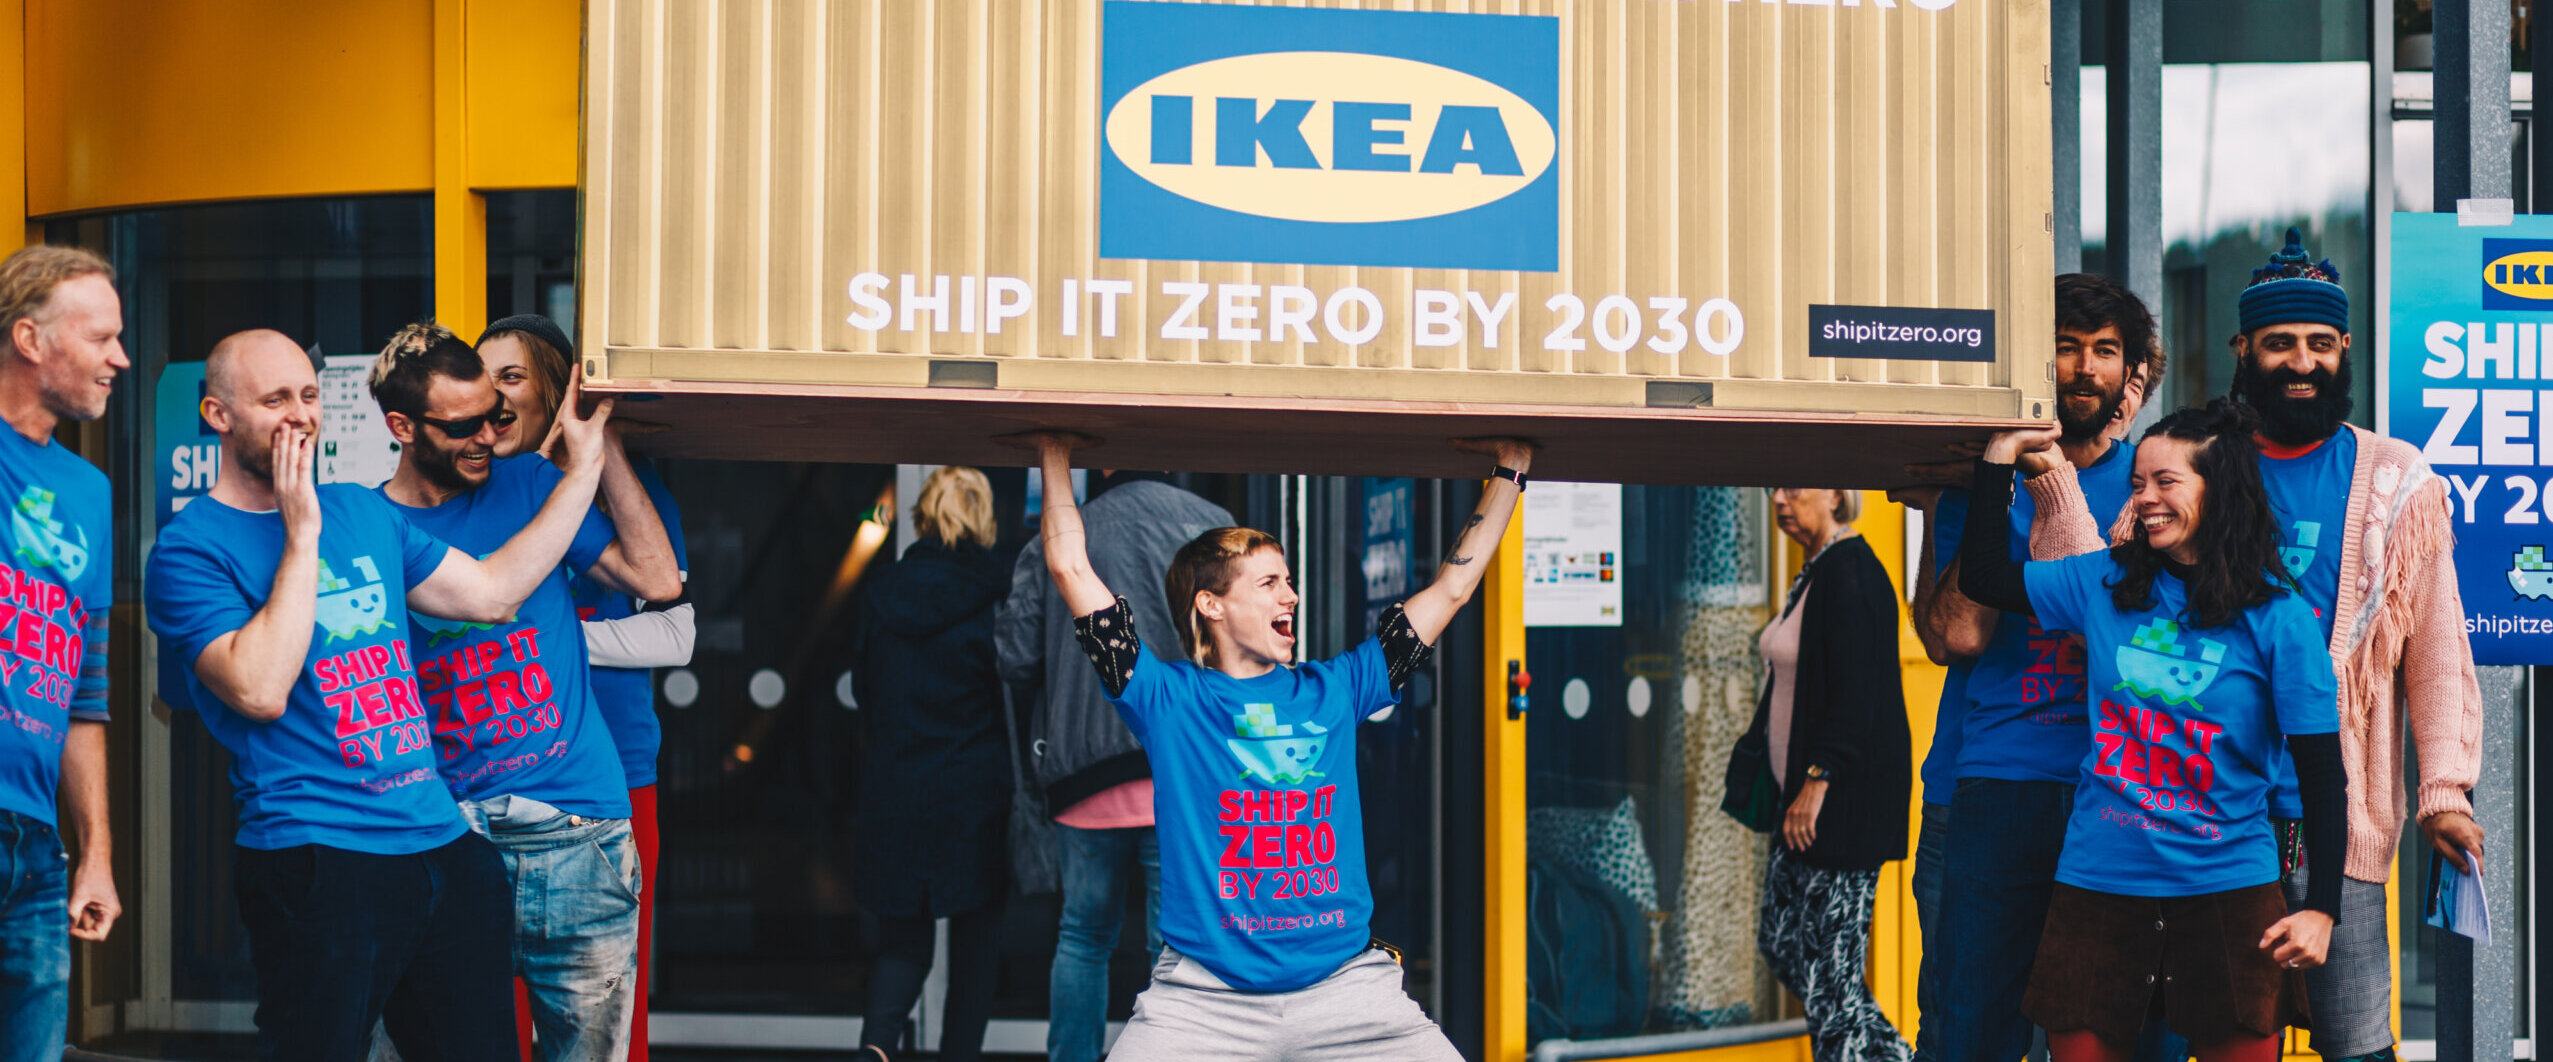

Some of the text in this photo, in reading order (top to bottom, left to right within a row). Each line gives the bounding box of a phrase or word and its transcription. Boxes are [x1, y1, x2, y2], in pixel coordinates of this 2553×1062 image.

[1150, 94, 1526, 177] IKEA
[846, 271, 1745, 356] SHIP IT ZERO BY 2030
[1822, 318, 1982, 348] shipitzero.org
[314, 644, 391, 692] SHIP
[418, 627, 540, 692] SHIP IT
[2023, 637, 2088, 676] ZE
[427, 662, 553, 735] ZERO
[2021, 677, 2064, 703] BY
[338, 730, 383, 769] BY
[440, 701, 562, 761] BY 2030
[2098, 698, 2223, 755] SHIP IT
[2093, 731, 2214, 793] ZERO
[1219, 784, 1337, 823] SHIP IT
[2136, 787, 2217, 816] 2030
[1218, 821, 1337, 869] ZERO
[1218, 865, 1340, 899] BY 2030
[1220, 908, 1347, 936] shipitzero.org
